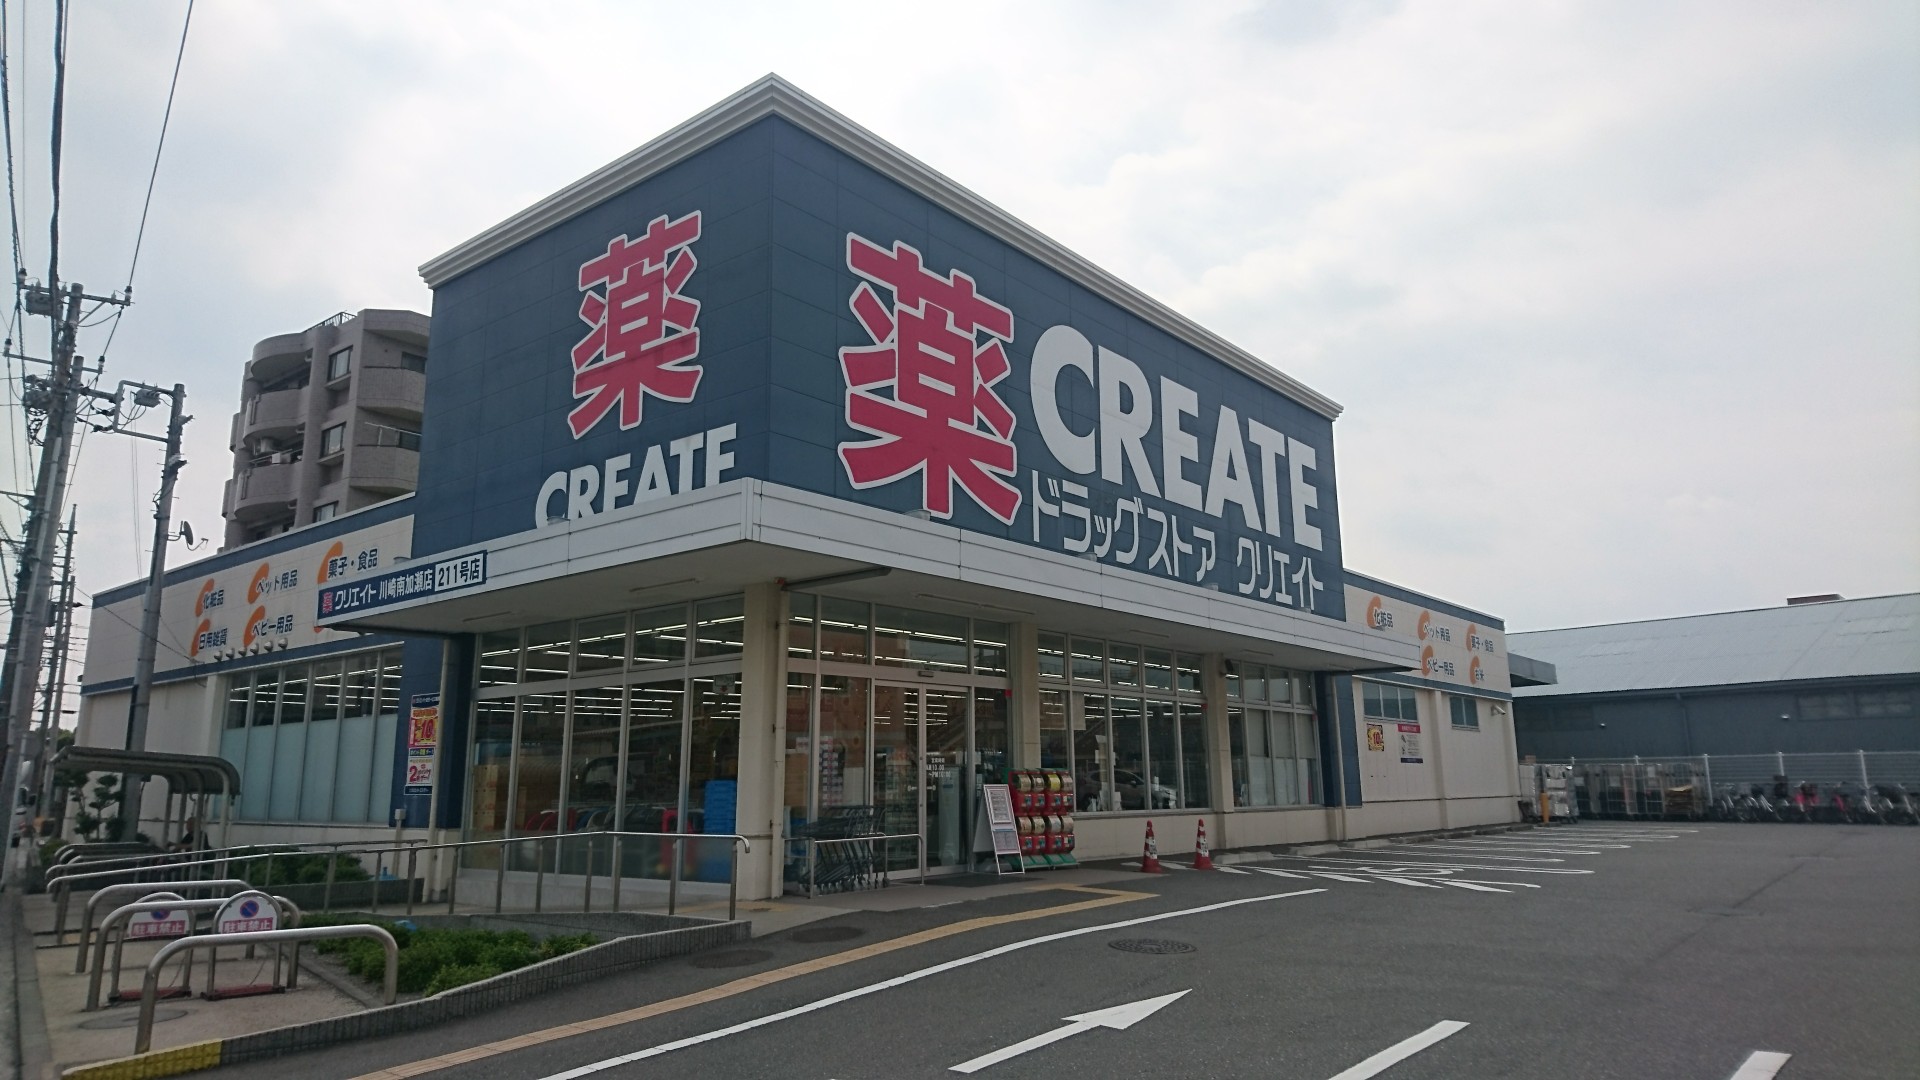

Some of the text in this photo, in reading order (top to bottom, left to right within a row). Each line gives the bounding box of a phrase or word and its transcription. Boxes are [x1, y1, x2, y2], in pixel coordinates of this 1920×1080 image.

[568, 210, 703, 439] 薬
[838, 232, 1022, 525] 薬
[1030, 325, 1323, 551] CREATE
[535, 423, 737, 529] CREATE
[1032, 470, 1324, 610] ドラッグストア クリエイト
[256, 569, 298, 594] ペット用品
[328, 548, 378, 579] 菓子・食品
[335, 583, 377, 610] クリエイト
[379, 569, 433, 600] 川崎南加瀬店
[438, 557, 480, 587] 211号店
[204, 589, 225, 609] 化粧品
[1374, 608, 1393, 628] 化粧品
[252, 614, 293, 637] ベビー用品
[224, 919, 271, 933] 駐車禁止
